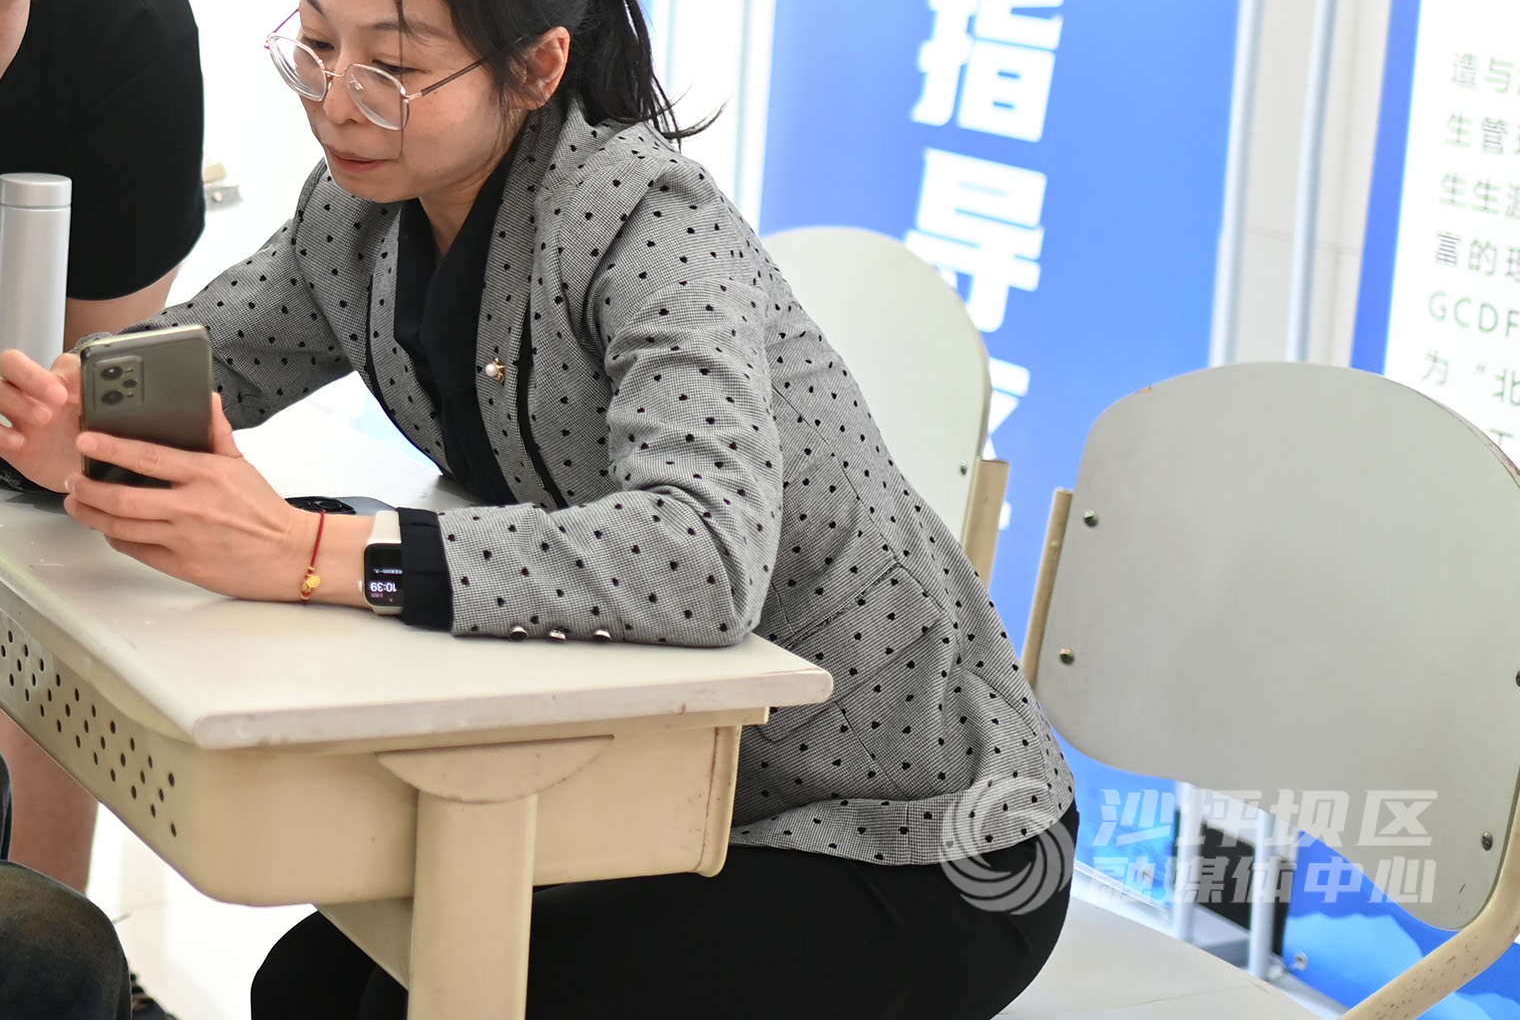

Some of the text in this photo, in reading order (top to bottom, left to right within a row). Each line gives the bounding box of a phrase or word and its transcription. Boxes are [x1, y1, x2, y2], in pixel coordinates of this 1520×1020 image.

[1451, 52, 1520, 94] 造与
[1445, 112, 1520, 155] 生管
[370, 582, 397, 592] 10:39
